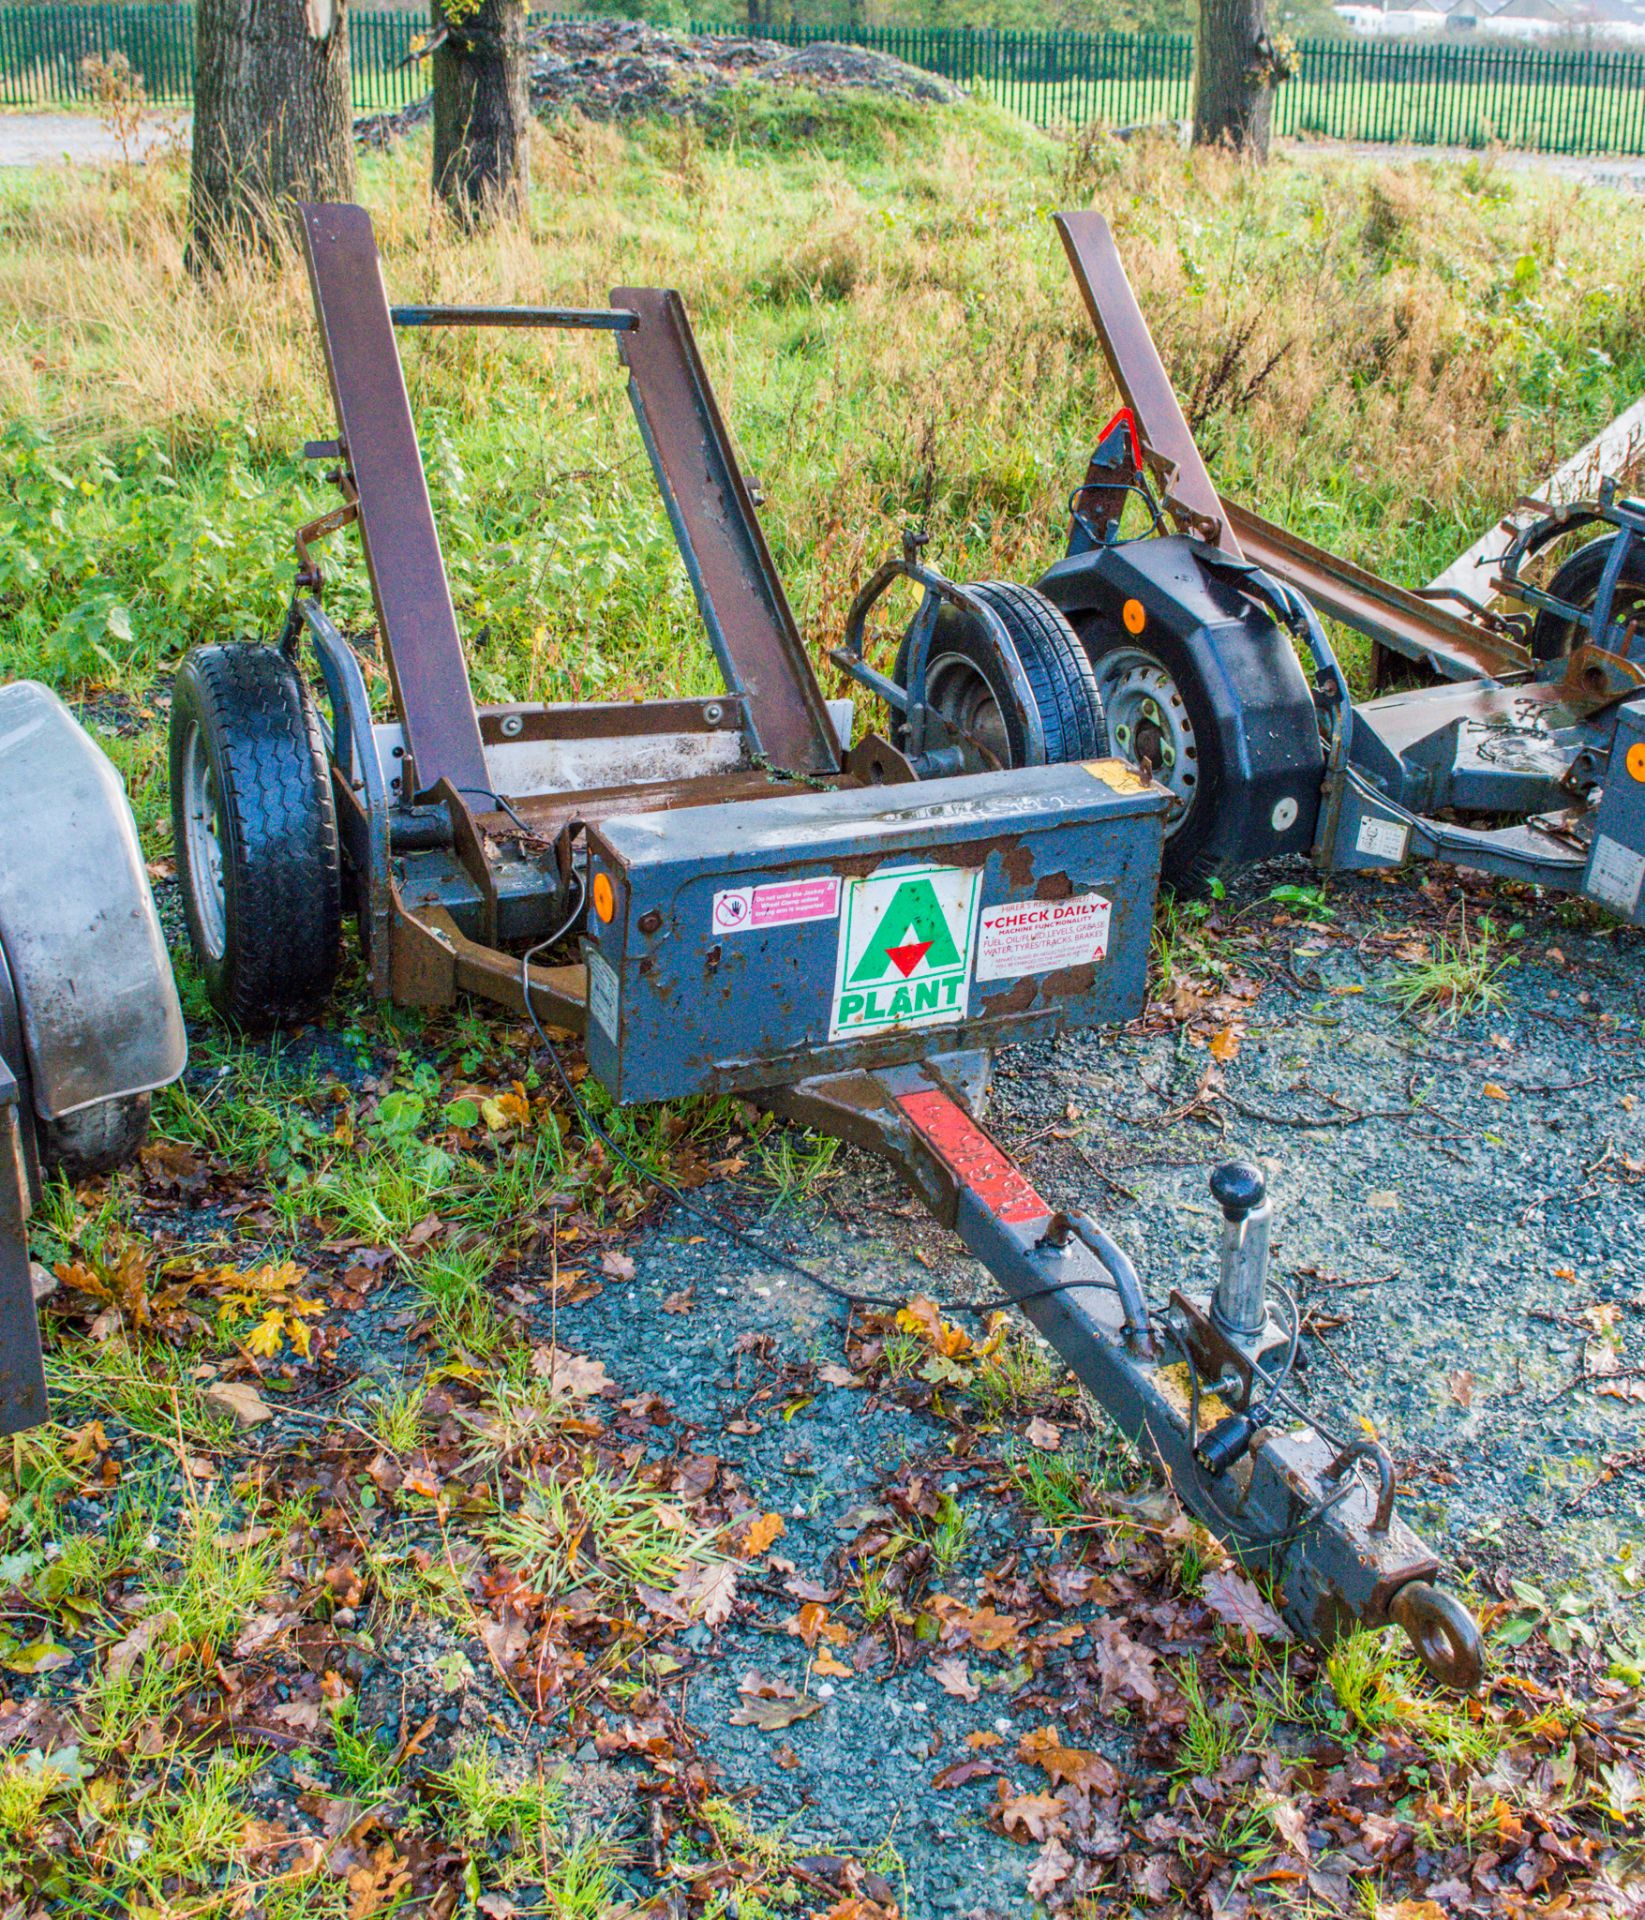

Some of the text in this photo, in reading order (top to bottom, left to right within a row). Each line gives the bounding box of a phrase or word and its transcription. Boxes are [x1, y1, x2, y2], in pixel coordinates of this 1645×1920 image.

[994, 903, 1099, 928] CHECK DAILY
[999, 915, 1092, 935] MACHINE FUNCTIONALITY
[1074, 929, 1104, 941] BRAKES
[838, 975, 965, 1024] PLANT
